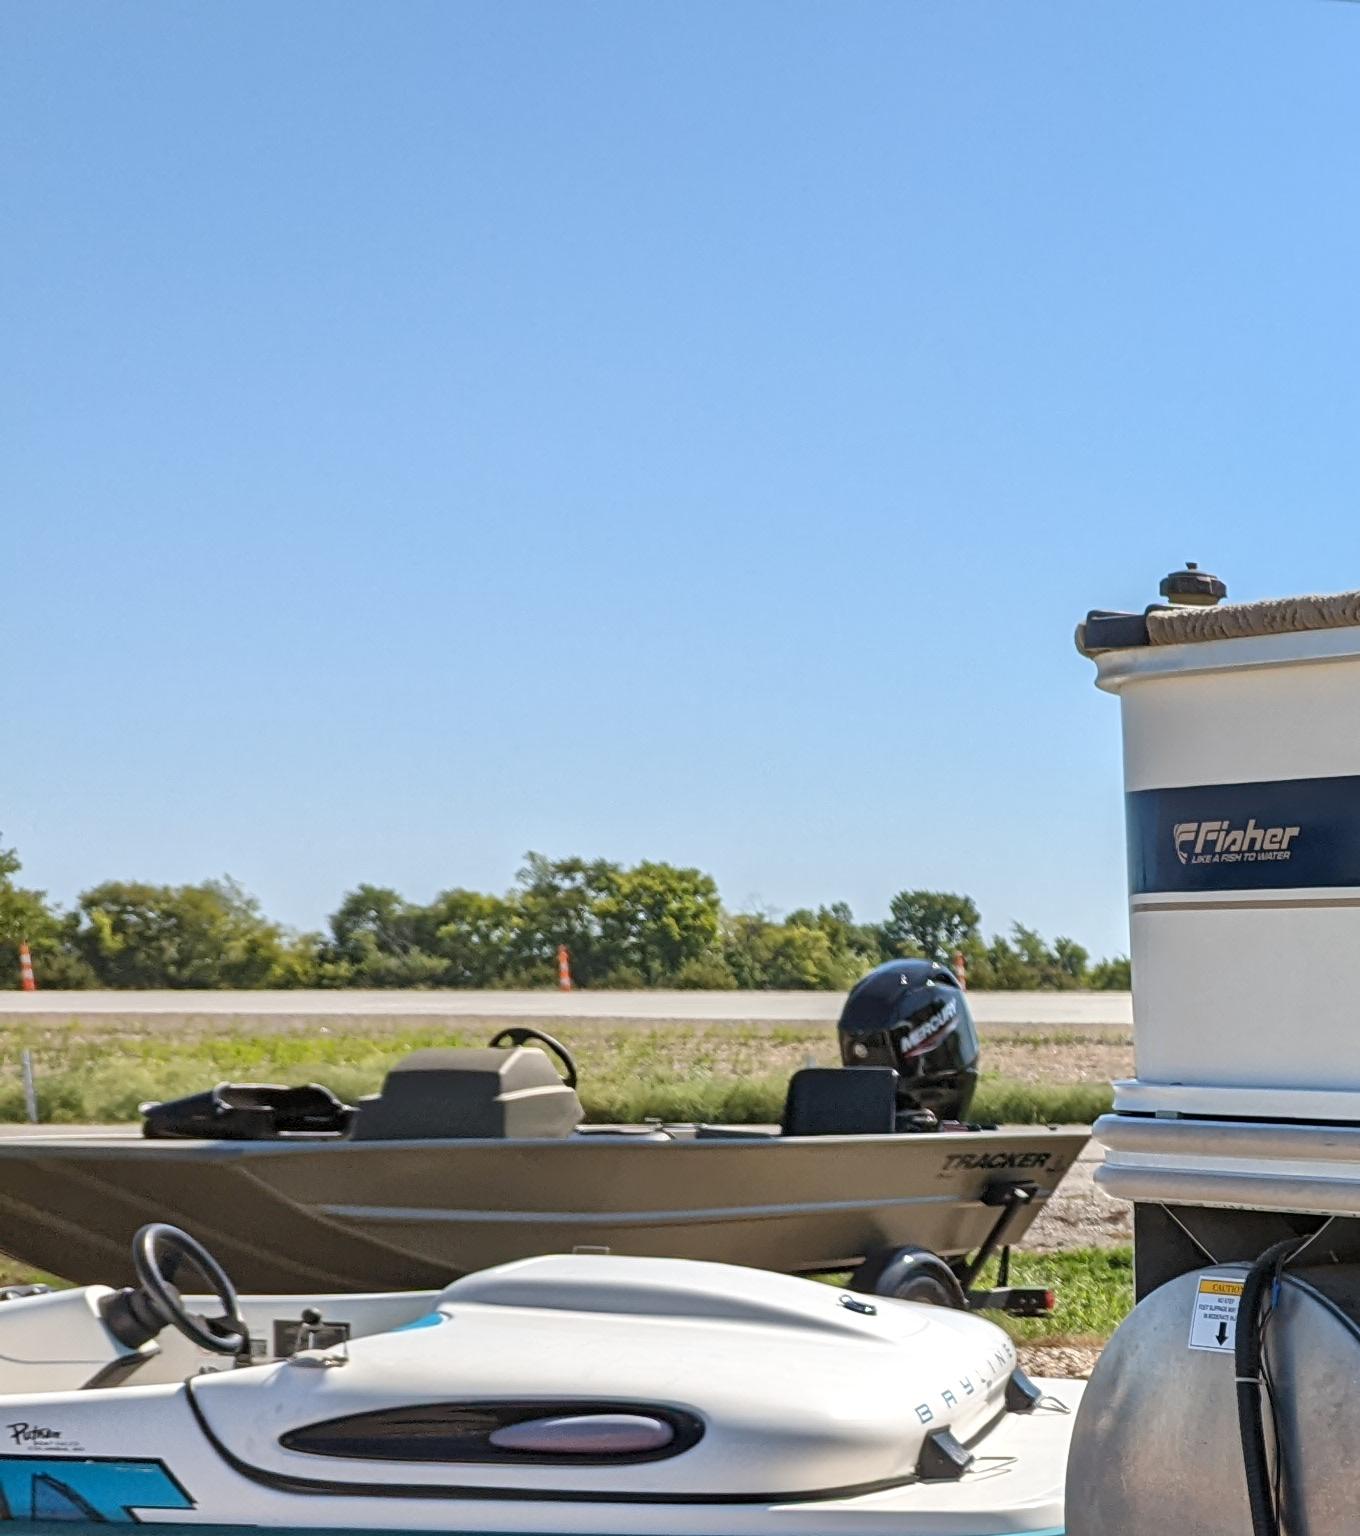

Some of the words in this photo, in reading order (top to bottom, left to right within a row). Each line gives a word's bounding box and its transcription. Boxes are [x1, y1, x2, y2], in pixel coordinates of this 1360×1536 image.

[1191, 853, 1212, 864] LIKE
[1212, 854, 1220, 863] A
[1243, 852, 1256, 862] TO
[1257, 851, 1291, 862] WATER
[901, 997, 957, 1053] MERCURY
[942, 1152, 1052, 1170] TRACKER
